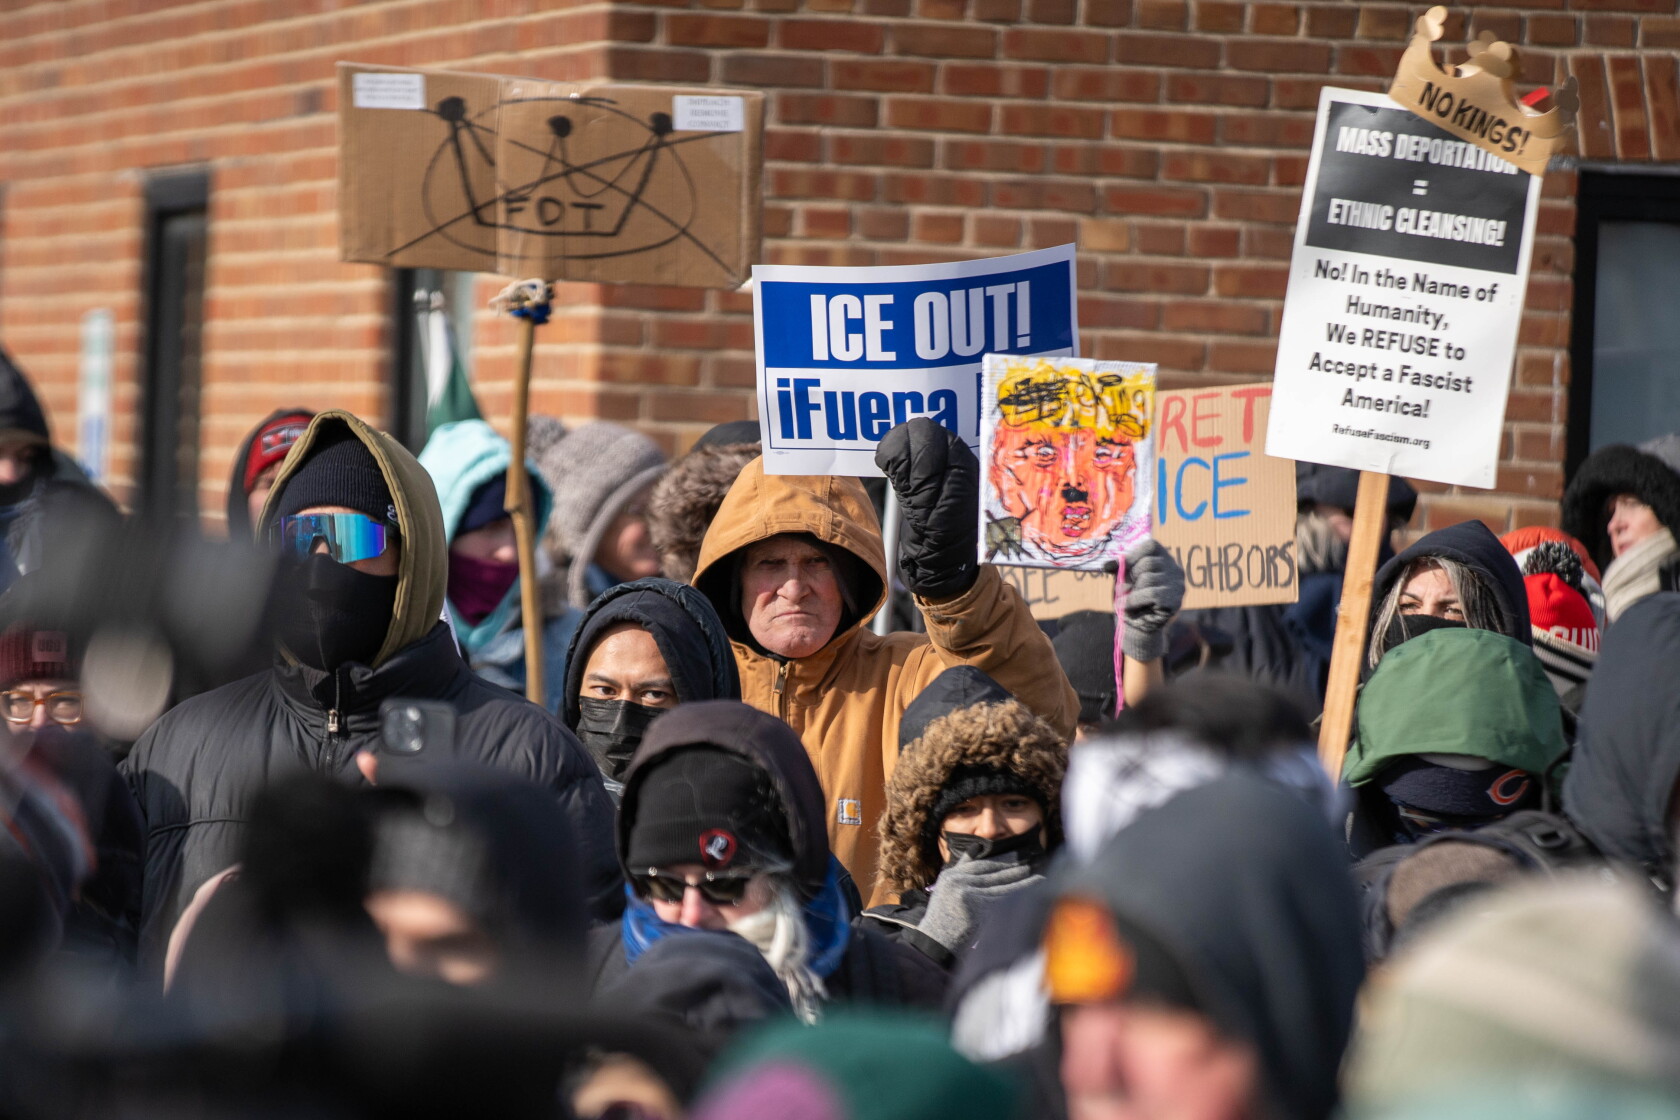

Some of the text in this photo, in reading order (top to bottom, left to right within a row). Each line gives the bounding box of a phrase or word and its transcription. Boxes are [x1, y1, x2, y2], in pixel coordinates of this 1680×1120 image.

[1336, 126, 1393, 158] MASS
[1327, 198, 1507, 247] ETHNIC CLEANSING!
[1314, 259, 1498, 302] No! In the Name of
[810, 280, 1031, 362] ICE OUT!
[1345, 295, 1449, 330] Humanity,
[1326, 323, 1466, 360] We REFUSE to
[1308, 352, 1473, 393] Accept a Fascist
[1341, 388, 1431, 418] America!
[1332, 424, 1430, 449] RefuseFascism.org
[1158, 451, 1251, 526] ICE
